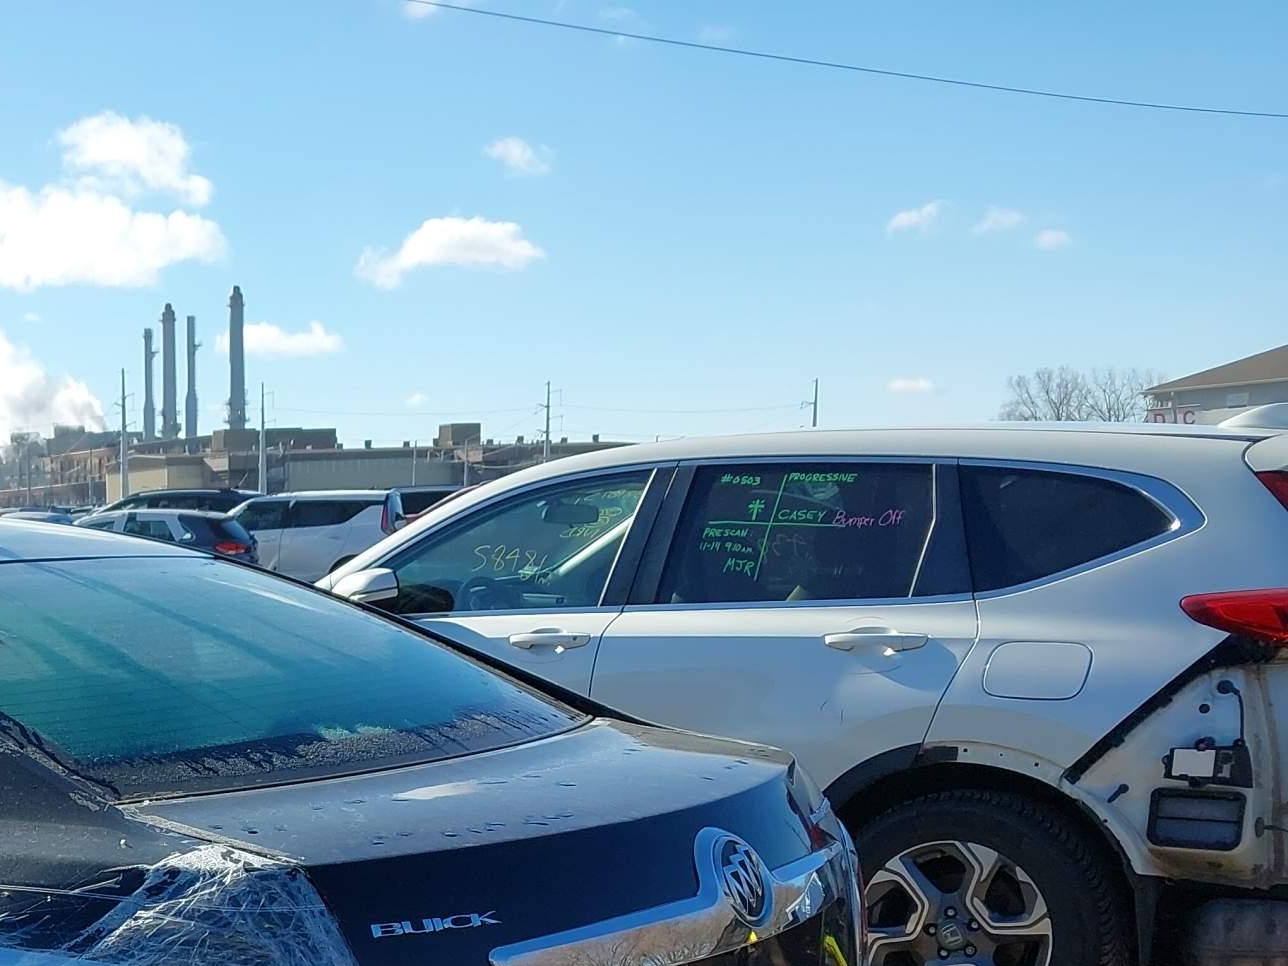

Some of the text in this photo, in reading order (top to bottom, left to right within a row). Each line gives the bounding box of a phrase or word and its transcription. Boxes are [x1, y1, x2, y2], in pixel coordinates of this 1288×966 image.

[788, 472, 858, 483] PROGRESSIVE
[777, 509, 827, 523] CASEY
[723, 558, 755, 576] MJR
[370, 910, 503, 938] BUICK
